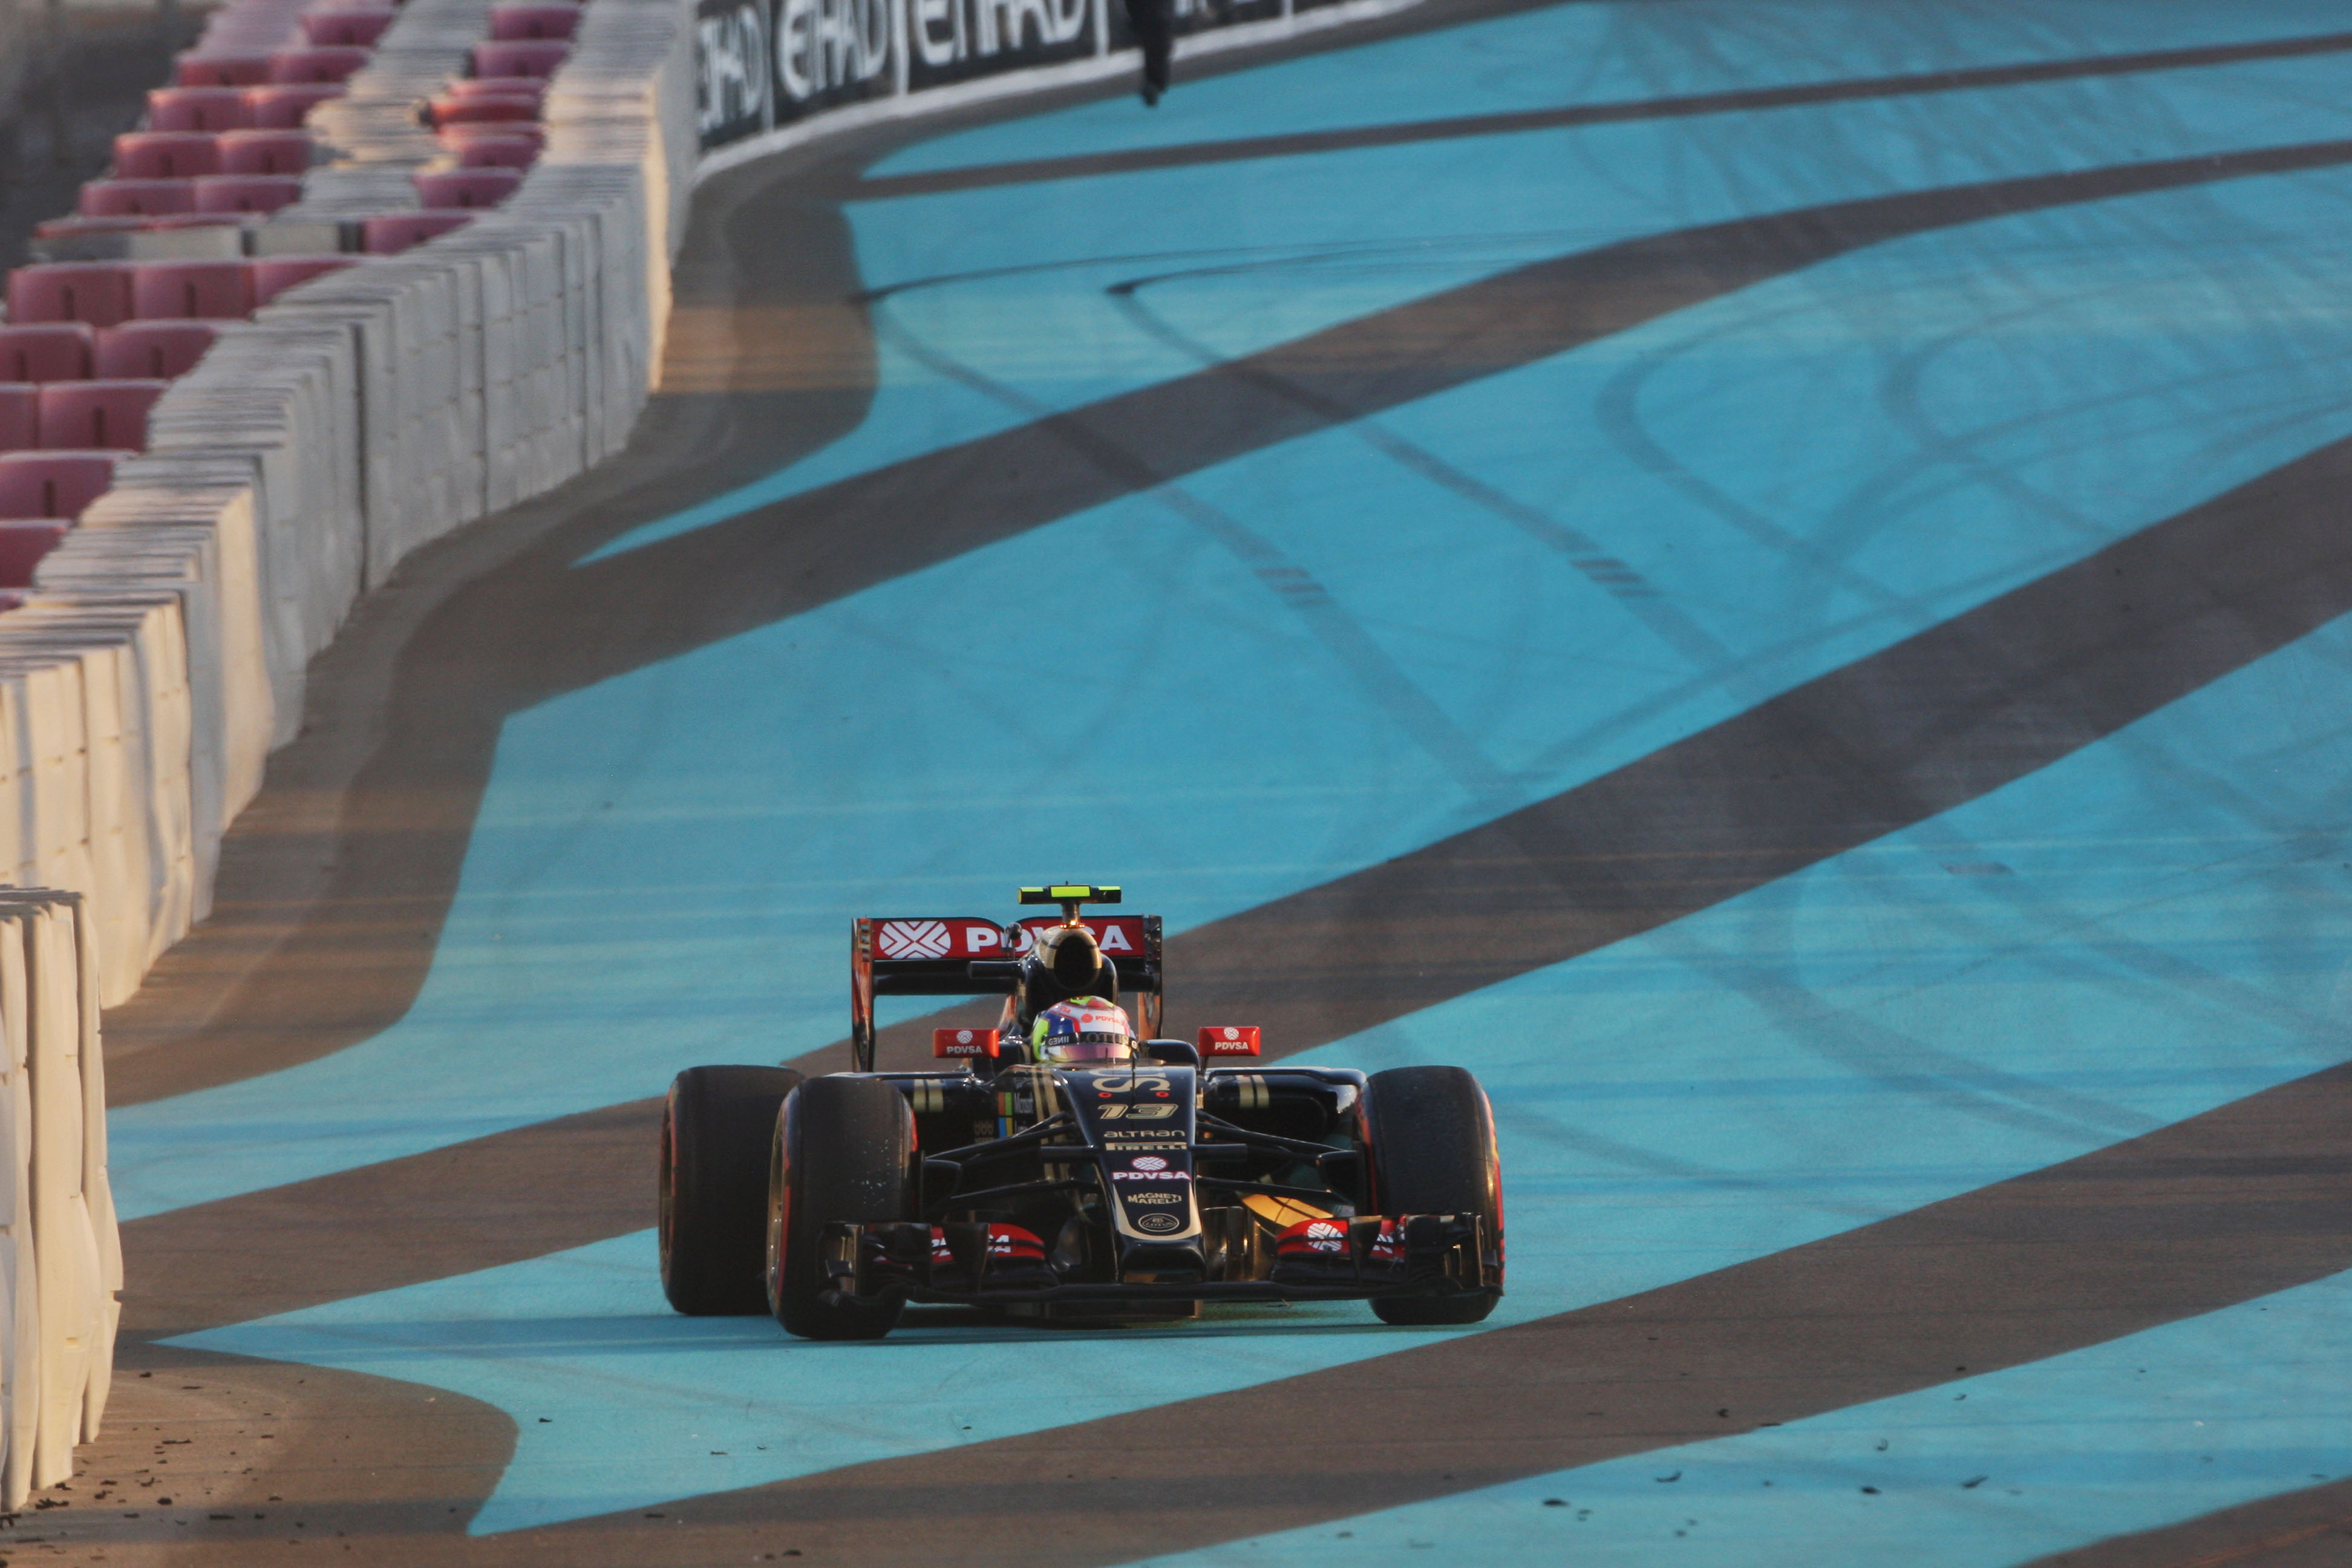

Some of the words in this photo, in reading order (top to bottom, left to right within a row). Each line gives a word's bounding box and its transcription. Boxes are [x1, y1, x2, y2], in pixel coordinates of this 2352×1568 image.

[966, 926, 1132, 952] PDA
[1097, 1103, 1179, 1119] 13
[1105, 1142, 1187, 1151] PIRELLI
[1112, 1171, 1191, 1180] PDVSA
